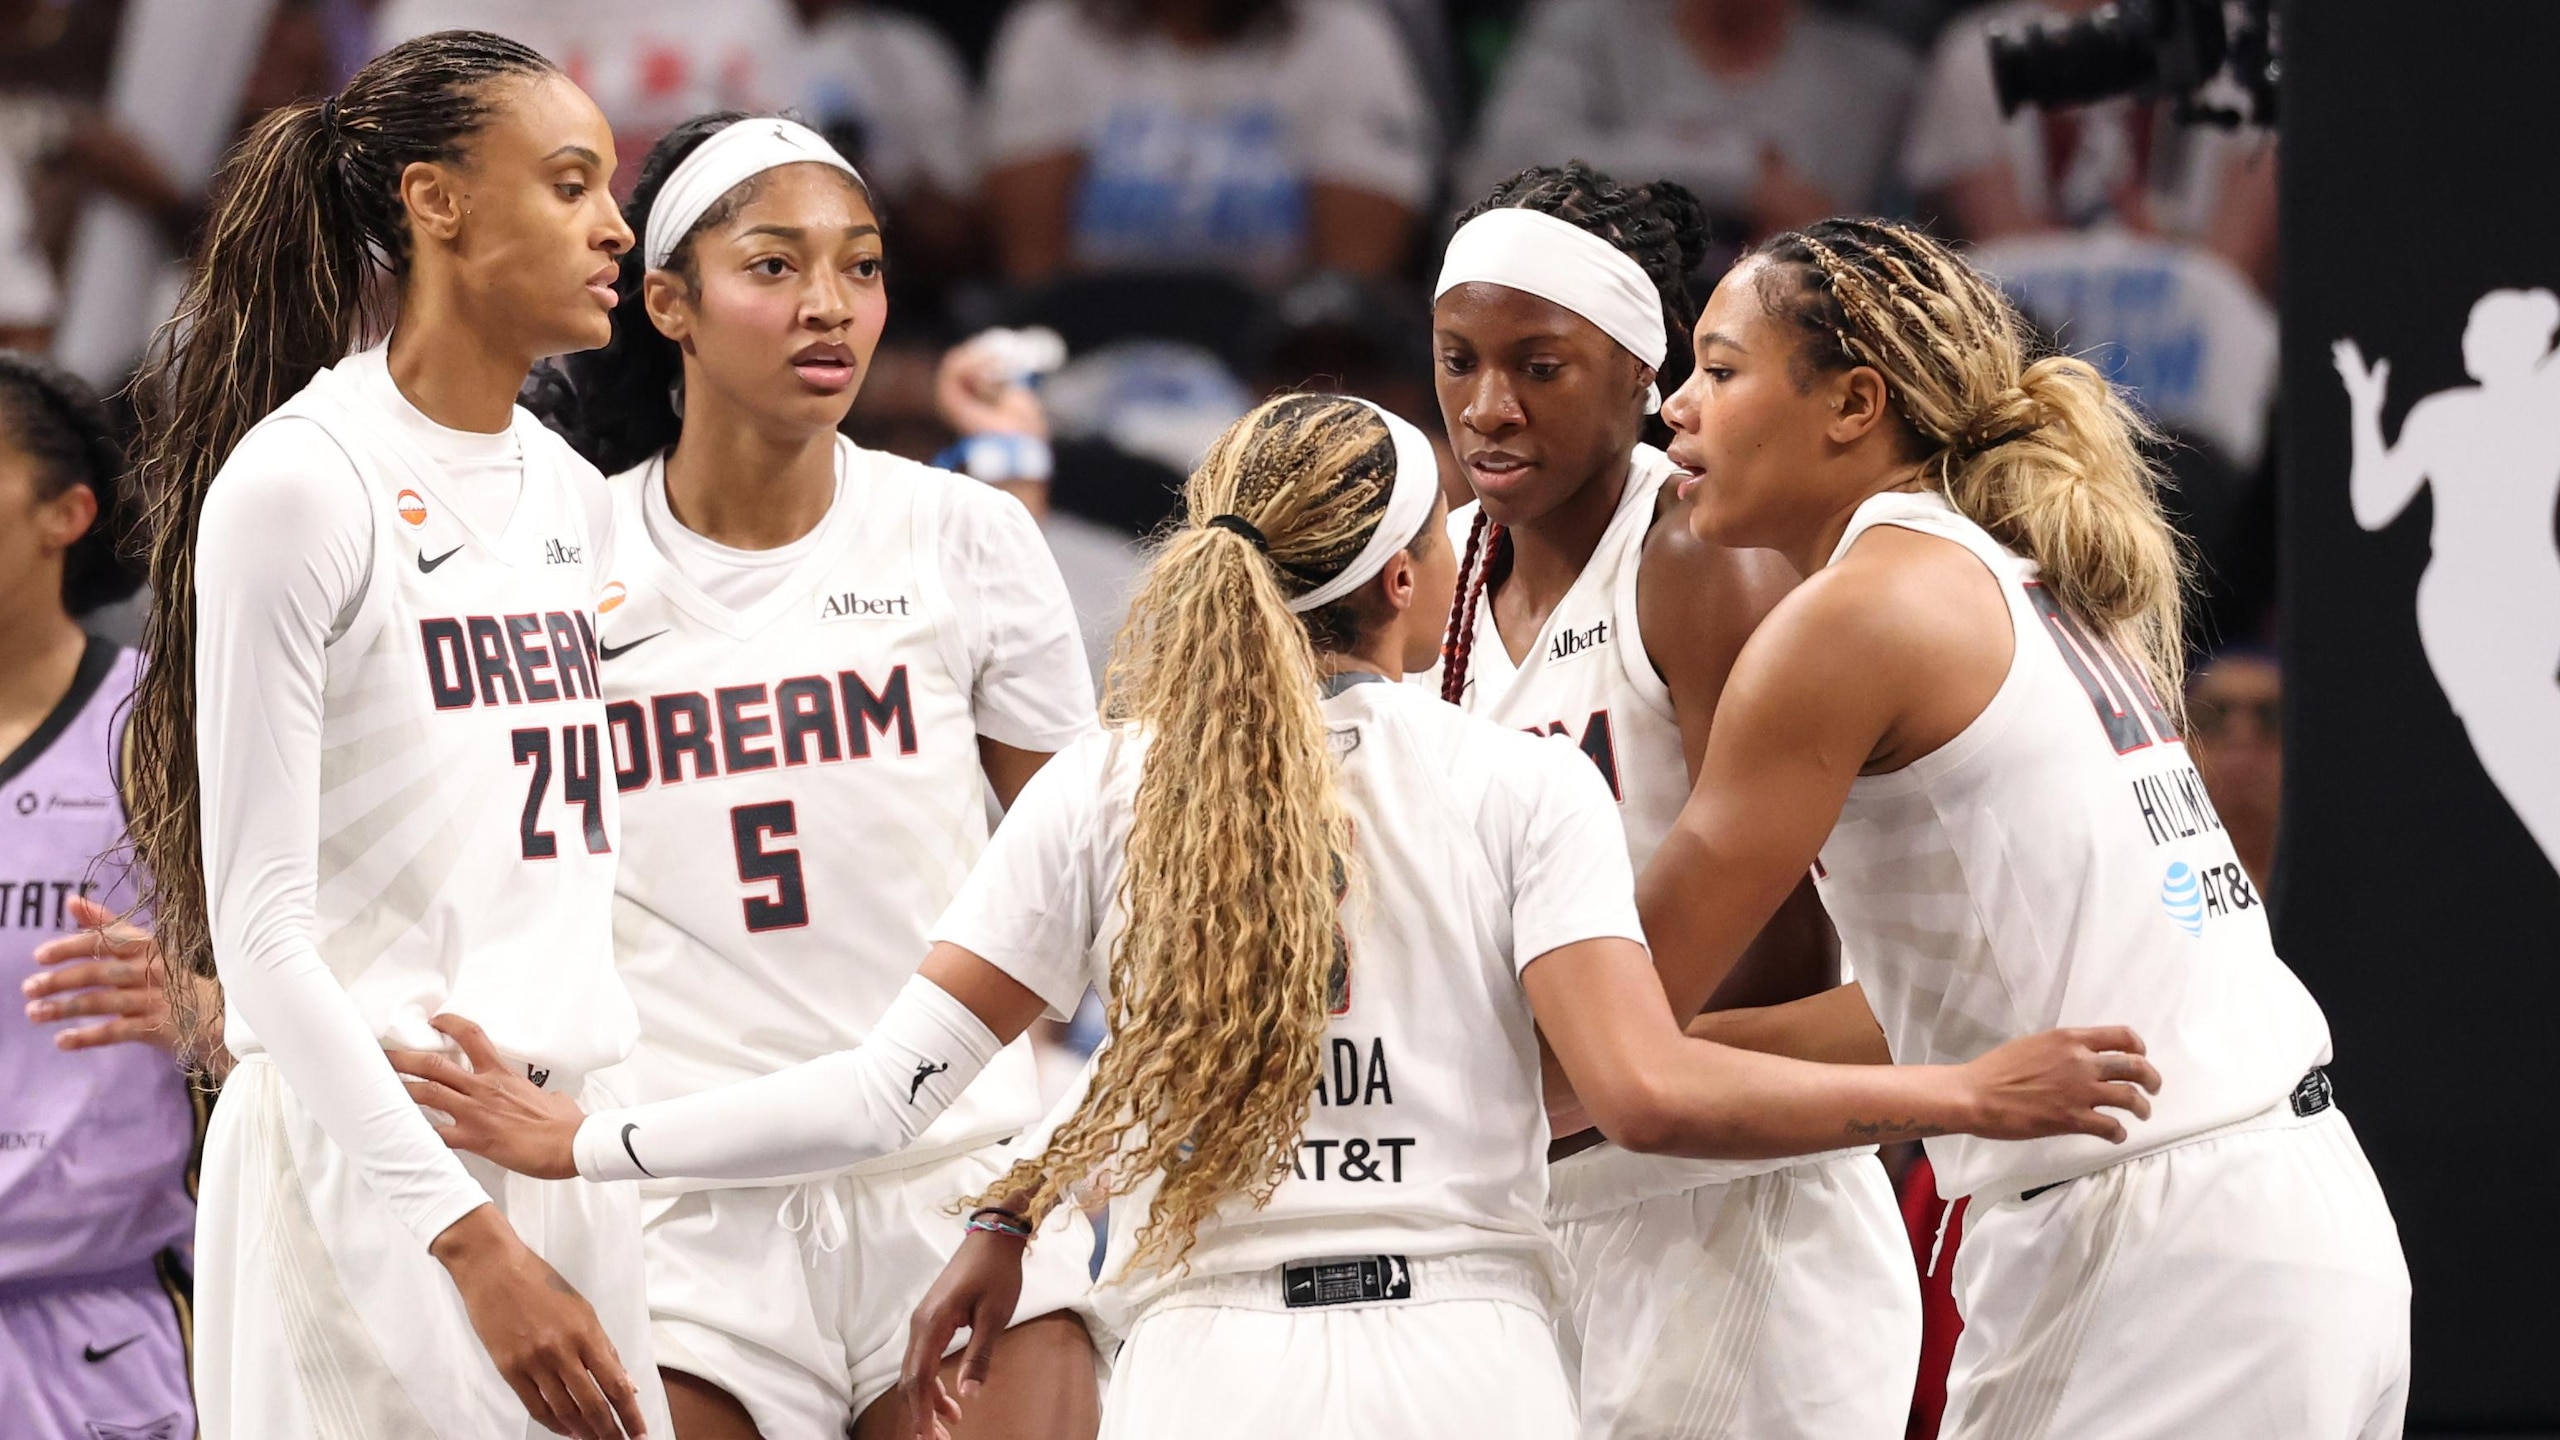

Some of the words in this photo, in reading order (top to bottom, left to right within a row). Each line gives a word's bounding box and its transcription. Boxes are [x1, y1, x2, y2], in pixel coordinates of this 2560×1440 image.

[820, 592, 911, 619] Albert
[1547, 620, 1608, 662] Albert
[510, 723, 613, 861] 24
[604, 664, 919, 794] DREAM
[729, 799, 810, 934] 5
